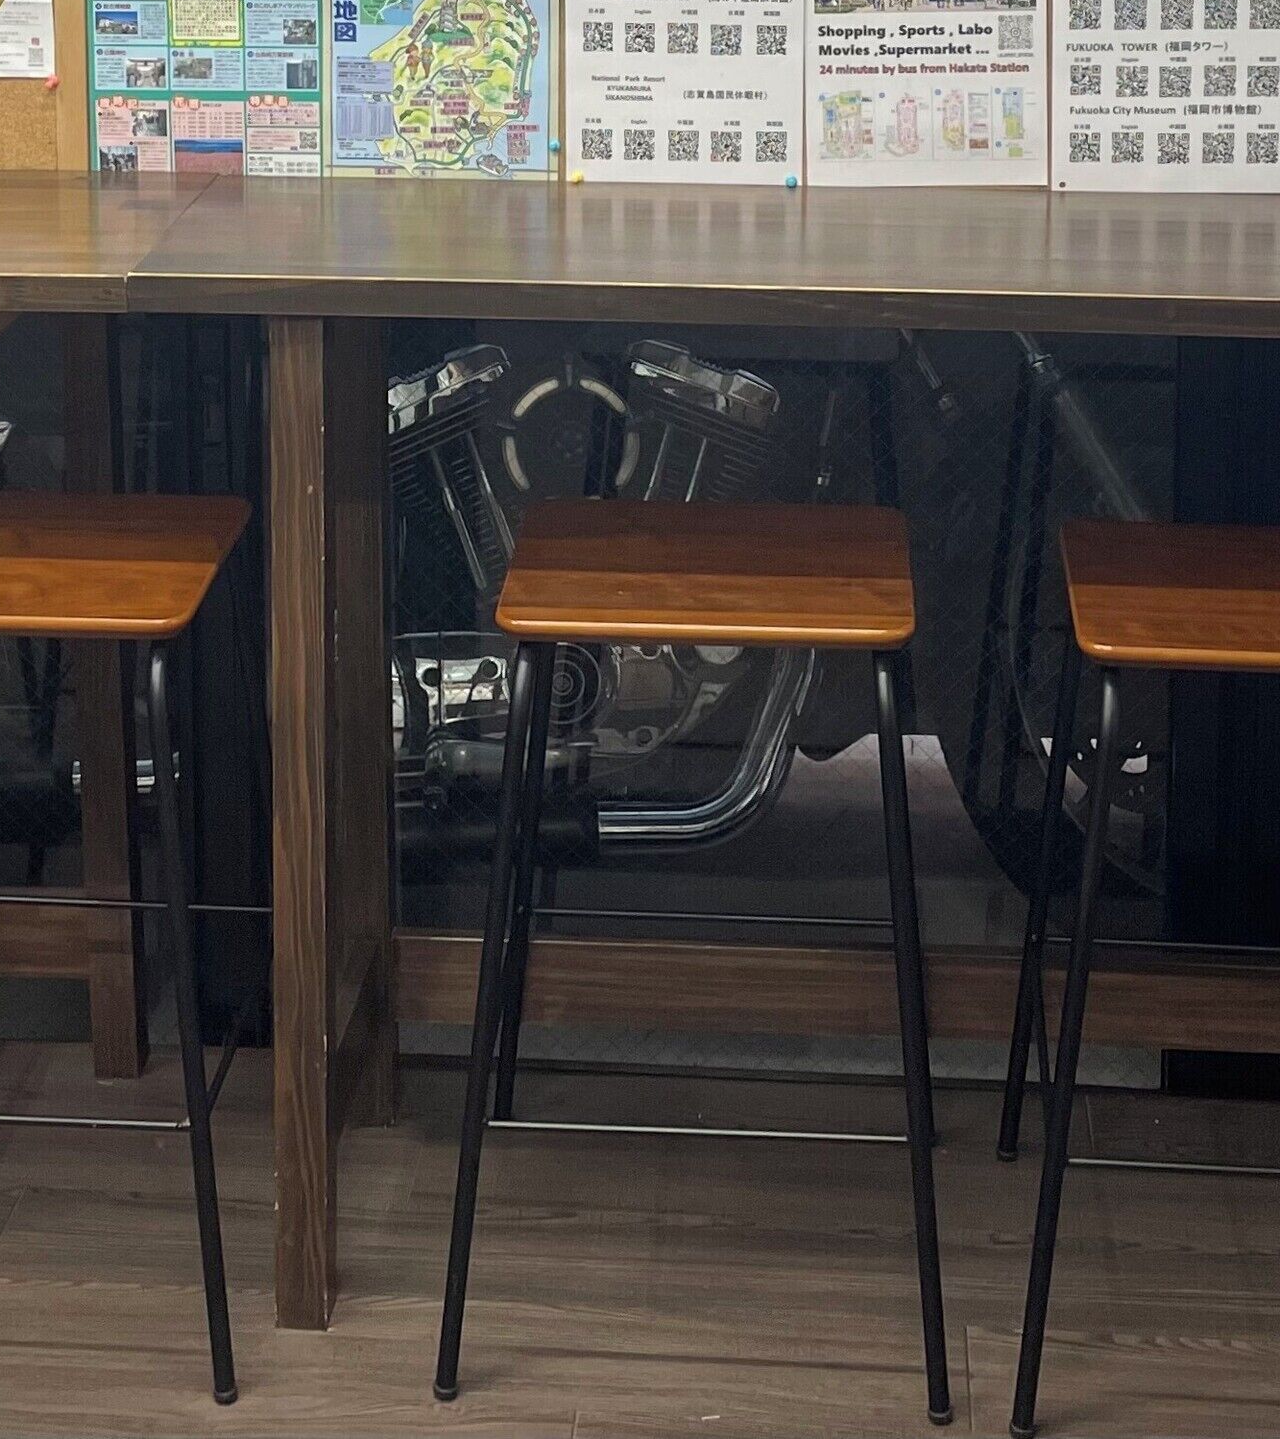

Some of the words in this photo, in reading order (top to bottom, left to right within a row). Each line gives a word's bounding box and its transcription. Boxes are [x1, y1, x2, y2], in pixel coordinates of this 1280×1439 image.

[818, 25, 886, 39] Shopping
[899, 24, 945, 38] Sports
[958, 24, 993, 35] Labo
[1066, 43, 1113, 52] FUKUOKA
[1121, 43, 1158, 52] TOWER
[1165, 42, 1229, 52] (福岡タワー)
[820, 65, 833, 74] 24
[836, 64, 879, 75] minutes
[882, 64, 895, 76] by
[898, 64, 917, 74] bus
[920, 63, 946, 73] from
[949, 63, 987, 73] Hakata
[990, 63, 1029, 73] Station
[1070, 106, 1110, 115] Fukuoka
[1113, 106, 1131, 116] City
[1133, 106, 1176, 114] Museum
[1184, 104, 1262, 115] (福岡市博物館)
